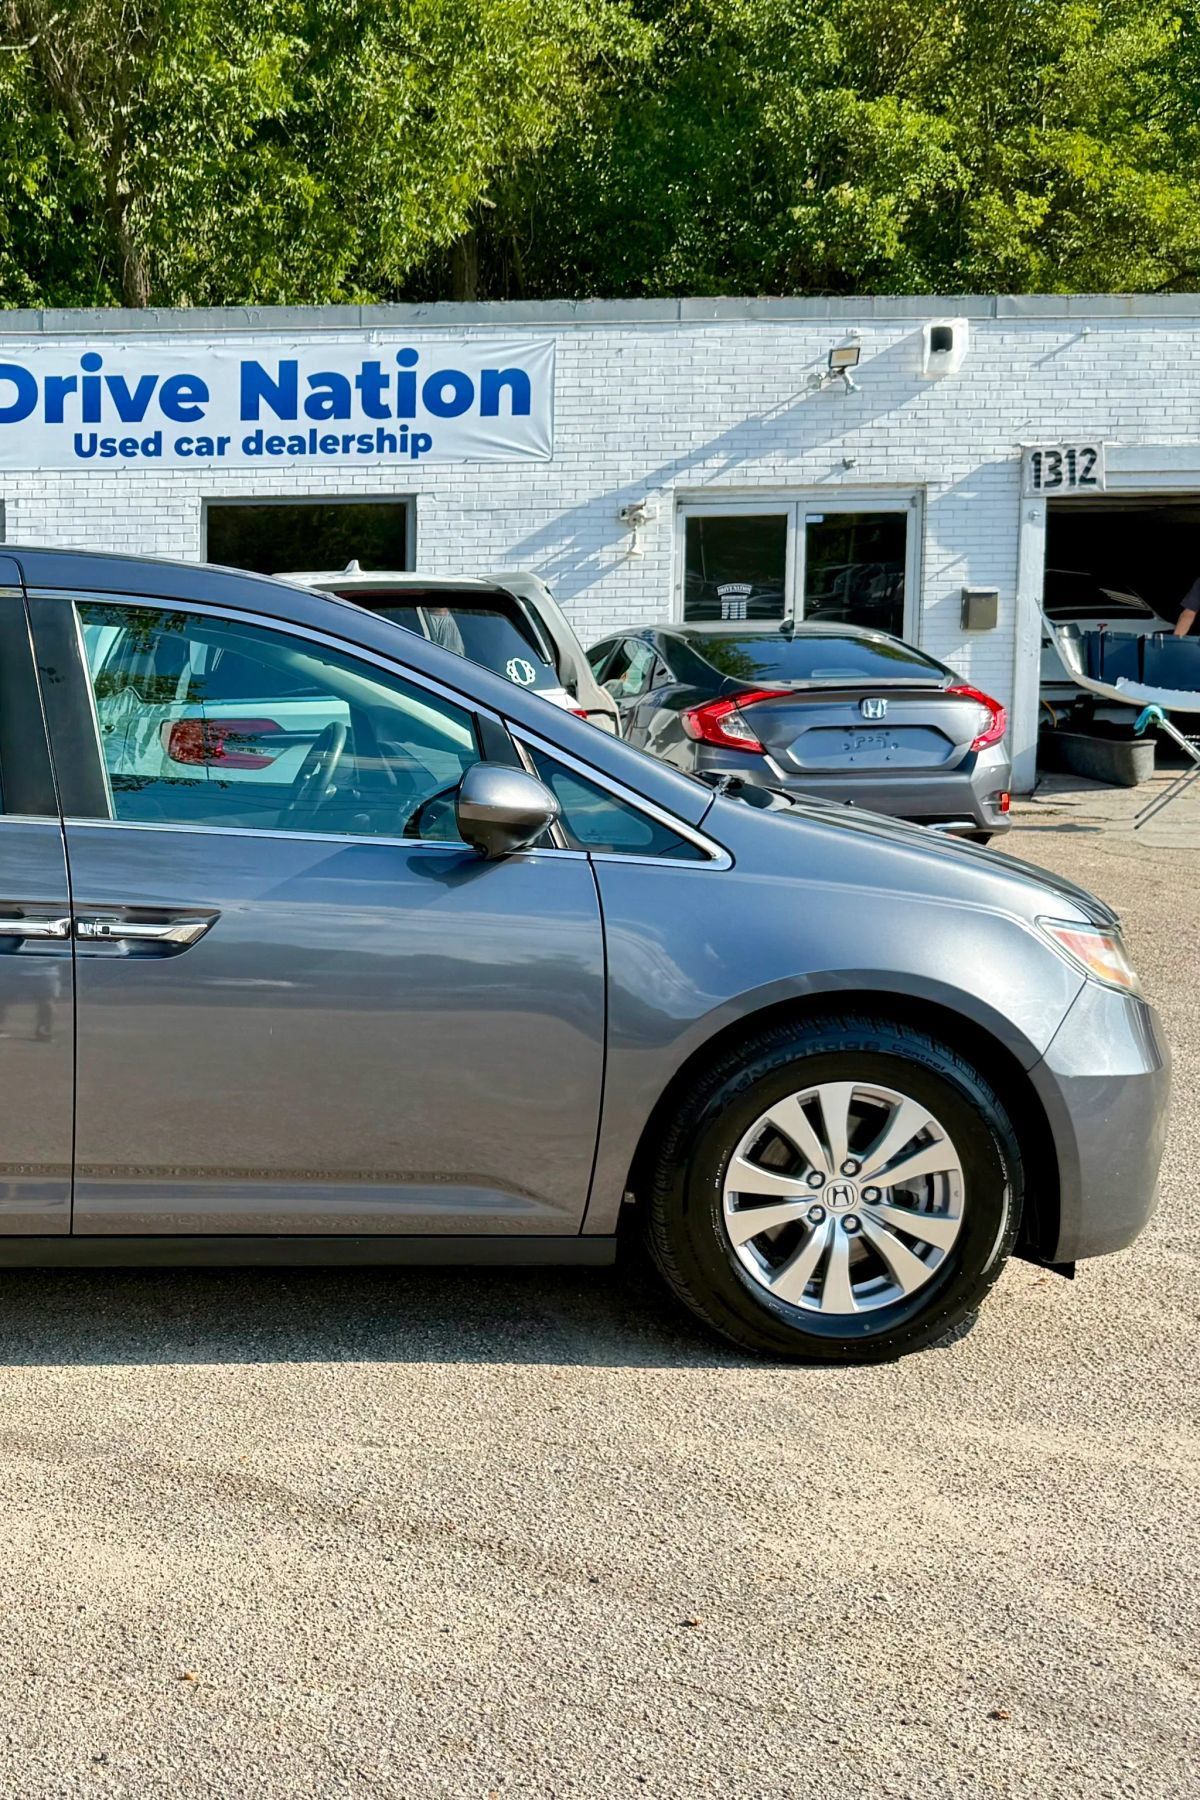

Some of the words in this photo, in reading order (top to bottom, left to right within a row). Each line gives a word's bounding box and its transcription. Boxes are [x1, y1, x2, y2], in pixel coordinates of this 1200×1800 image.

[239, 347, 532, 422] Nation
[73, 430, 163, 459] Used
[173, 436, 231, 458] car
[241, 423, 433, 460] dealership
[1030, 447, 1098, 489] 1312
